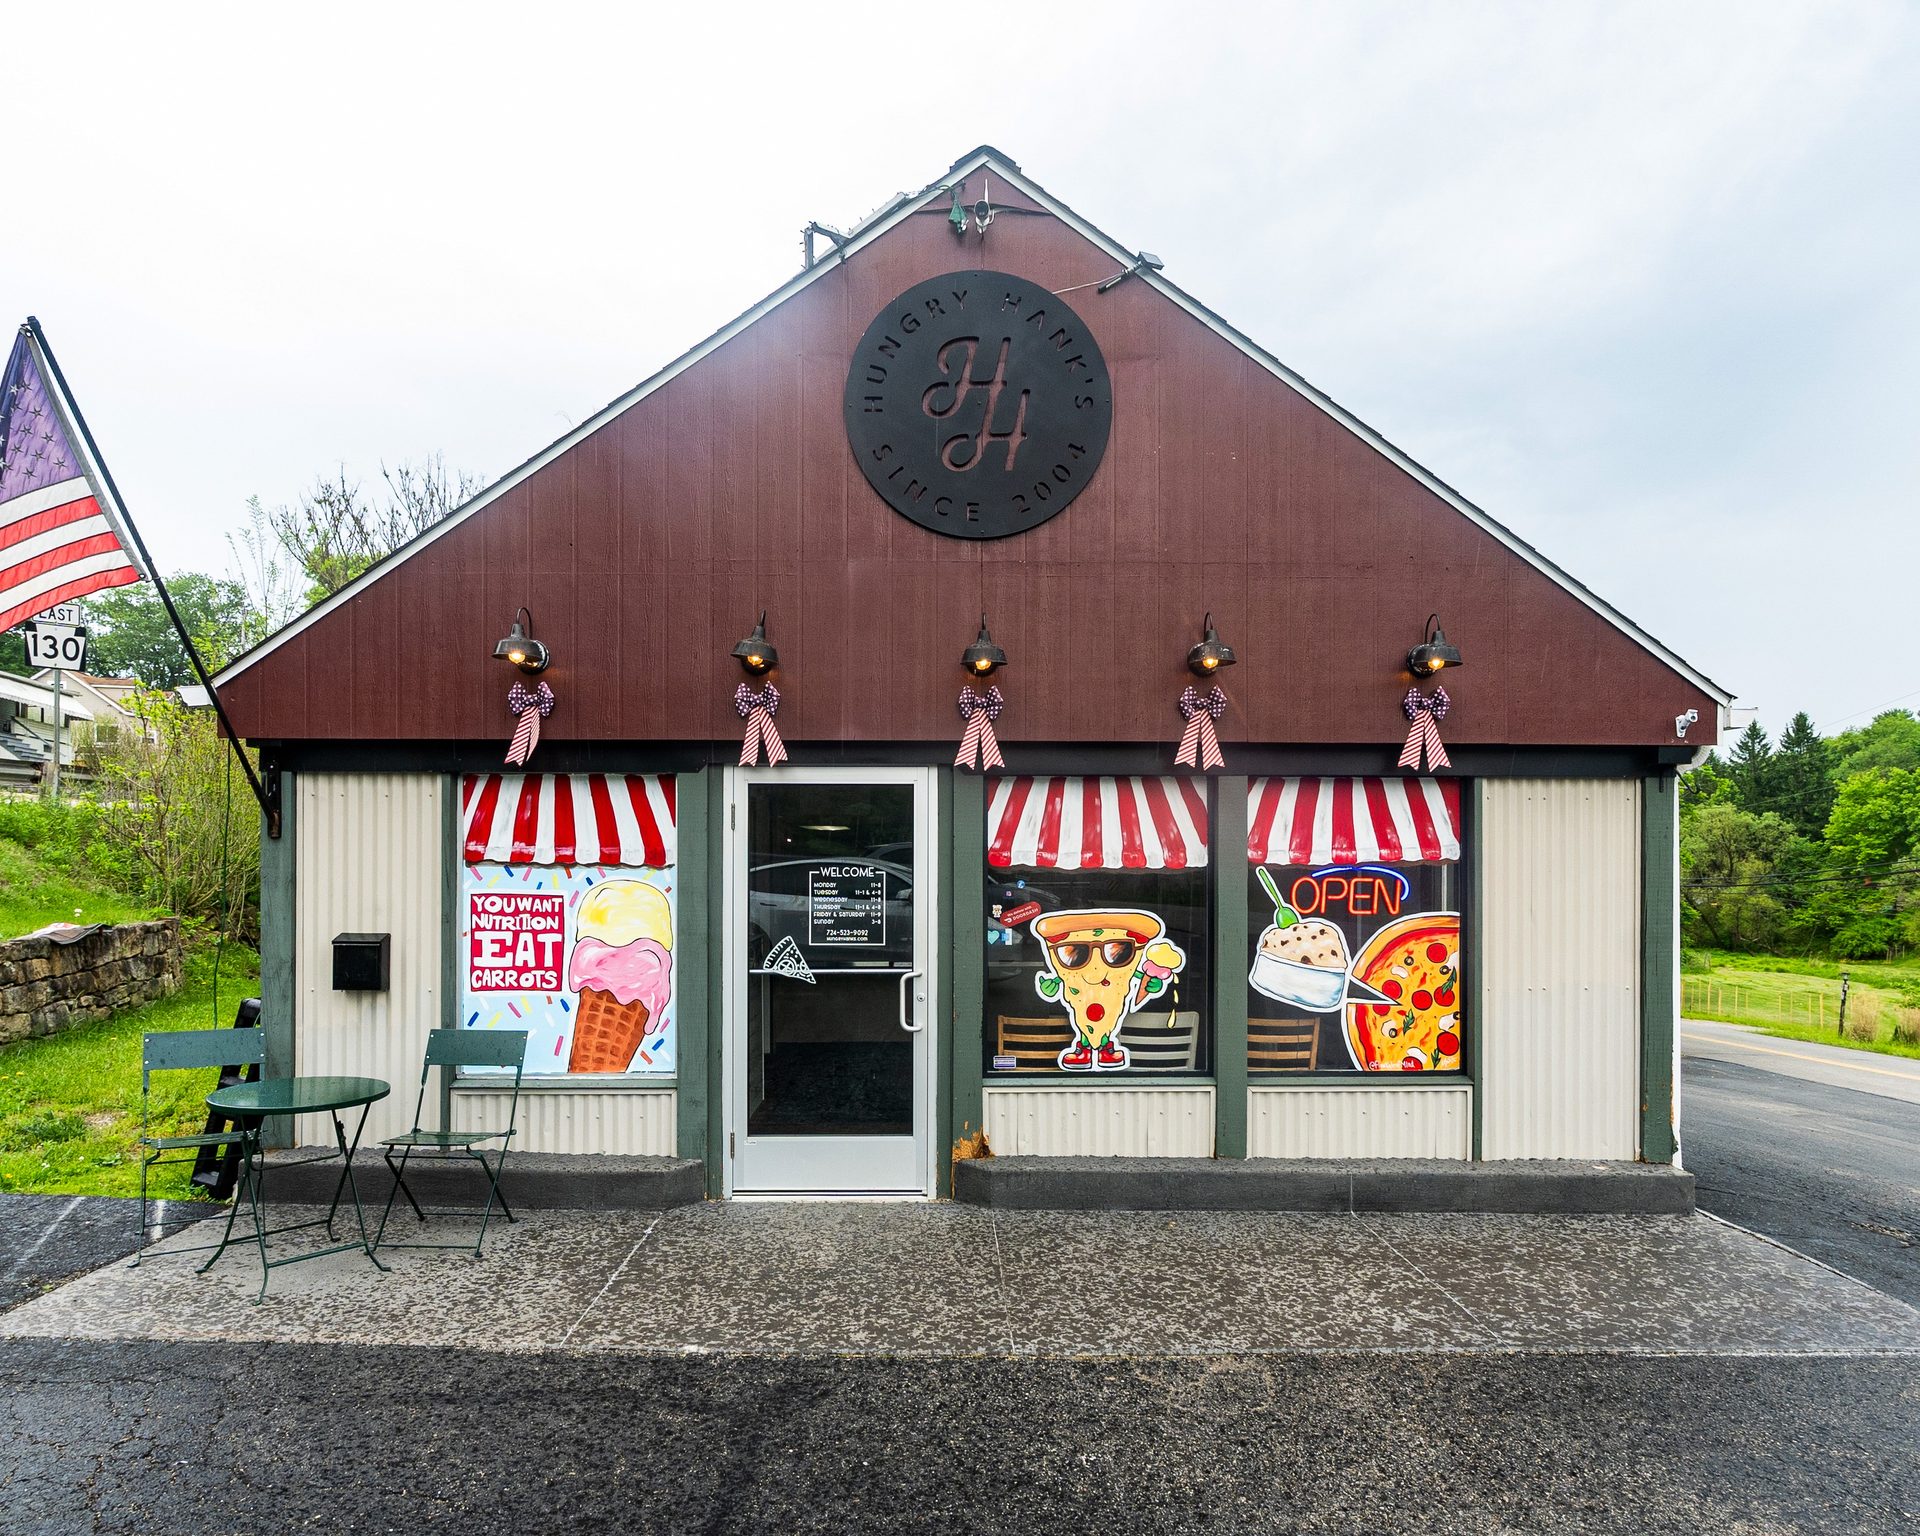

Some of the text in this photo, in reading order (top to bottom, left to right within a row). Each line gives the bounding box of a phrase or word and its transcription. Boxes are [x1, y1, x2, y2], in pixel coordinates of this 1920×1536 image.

[864, 290, 1094, 413] HUNGRY HANK'S
[872, 442, 1087, 522] SINCE 2004
[31, 633, 80, 661] 130
[820, 867, 874, 877] WELCOME
[472, 895, 563, 914] YOU WANT
[1291, 876, 1401, 915] OPEN
[471, 913, 559, 930] NUTRITION
[473, 931, 563, 968] EAT
[471, 969, 558, 989] CARROTS
